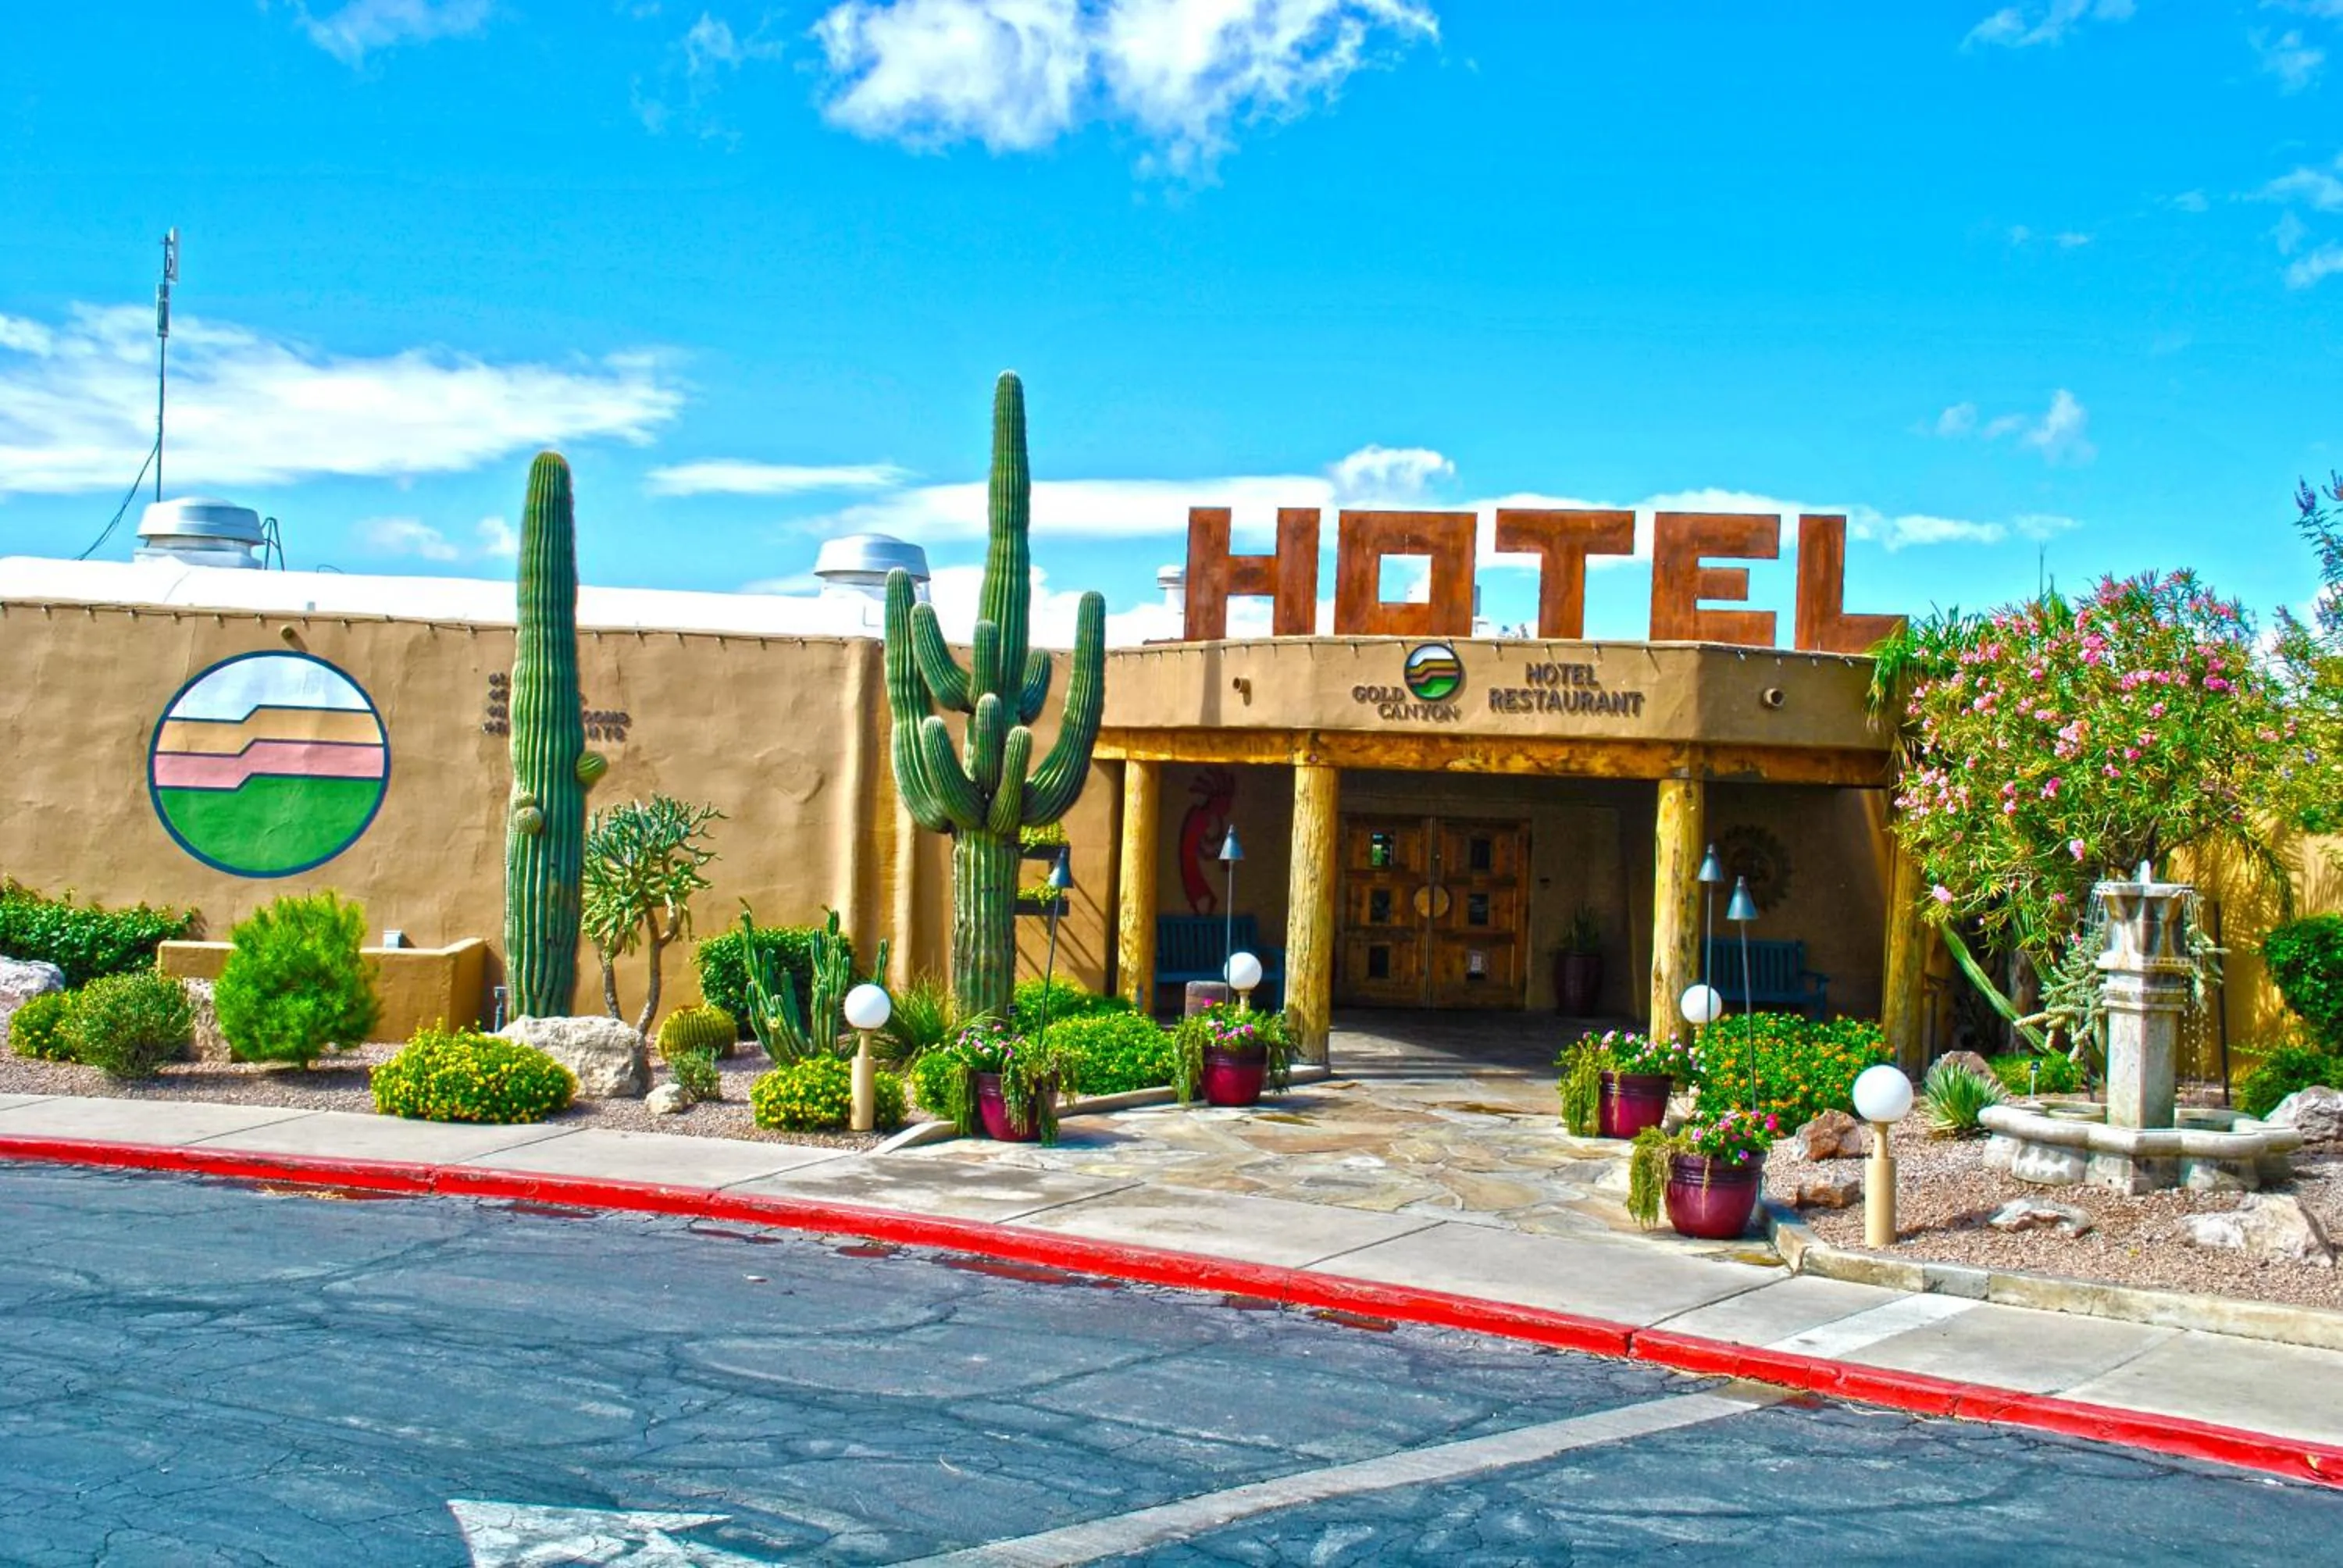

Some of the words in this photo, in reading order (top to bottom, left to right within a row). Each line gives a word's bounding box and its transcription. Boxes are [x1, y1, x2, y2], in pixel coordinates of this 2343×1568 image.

[1184, 507, 1909, 654] HOTEL
[1526, 662, 1601, 688] HOTEL
[1353, 685, 1406, 704] GOLD
[1488, 687, 1645, 717] RESTAURANT
[1378, 703, 1462, 722] CANYON
